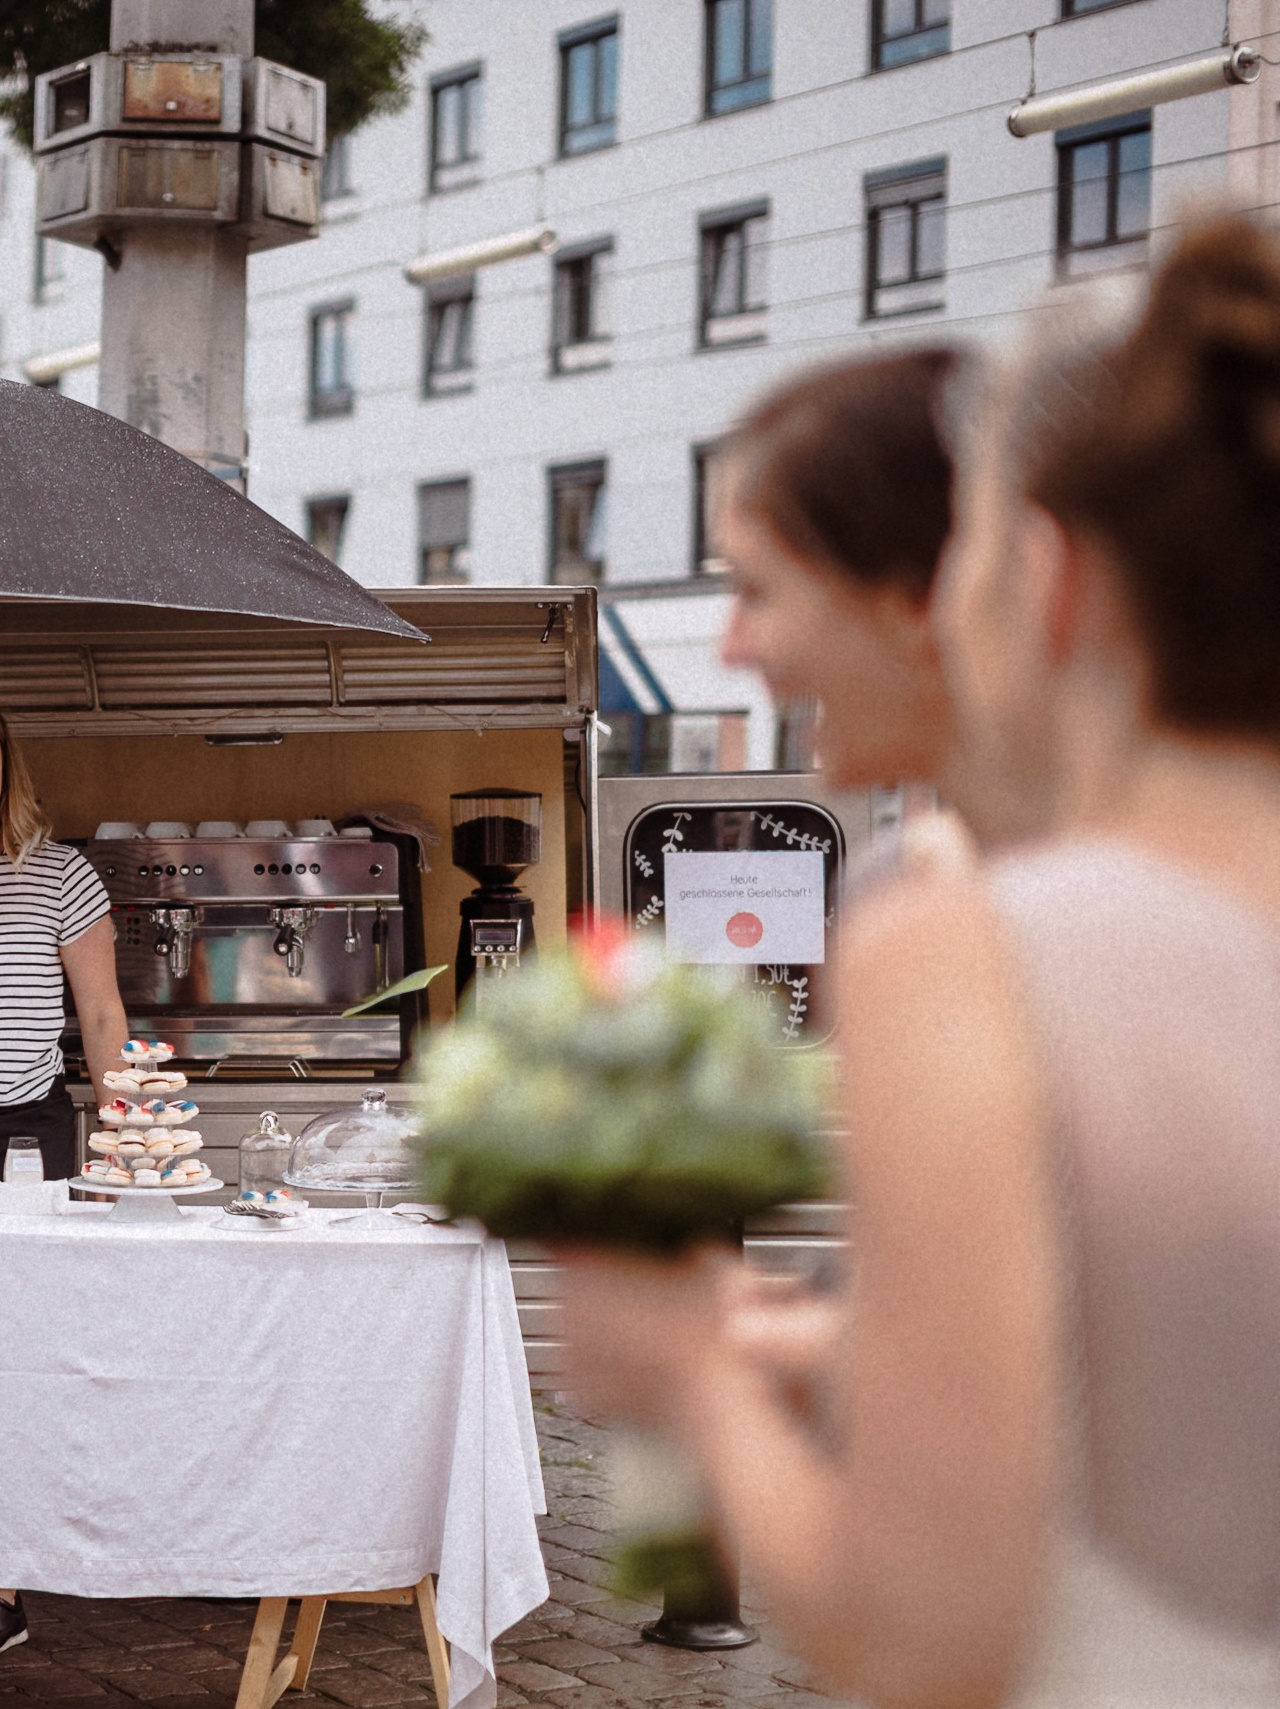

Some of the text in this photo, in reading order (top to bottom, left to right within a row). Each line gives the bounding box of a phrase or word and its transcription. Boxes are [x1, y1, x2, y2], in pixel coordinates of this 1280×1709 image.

[730, 875, 758, 885] Heute
[679, 887, 812, 900] geschlossene Gesellschaft!
